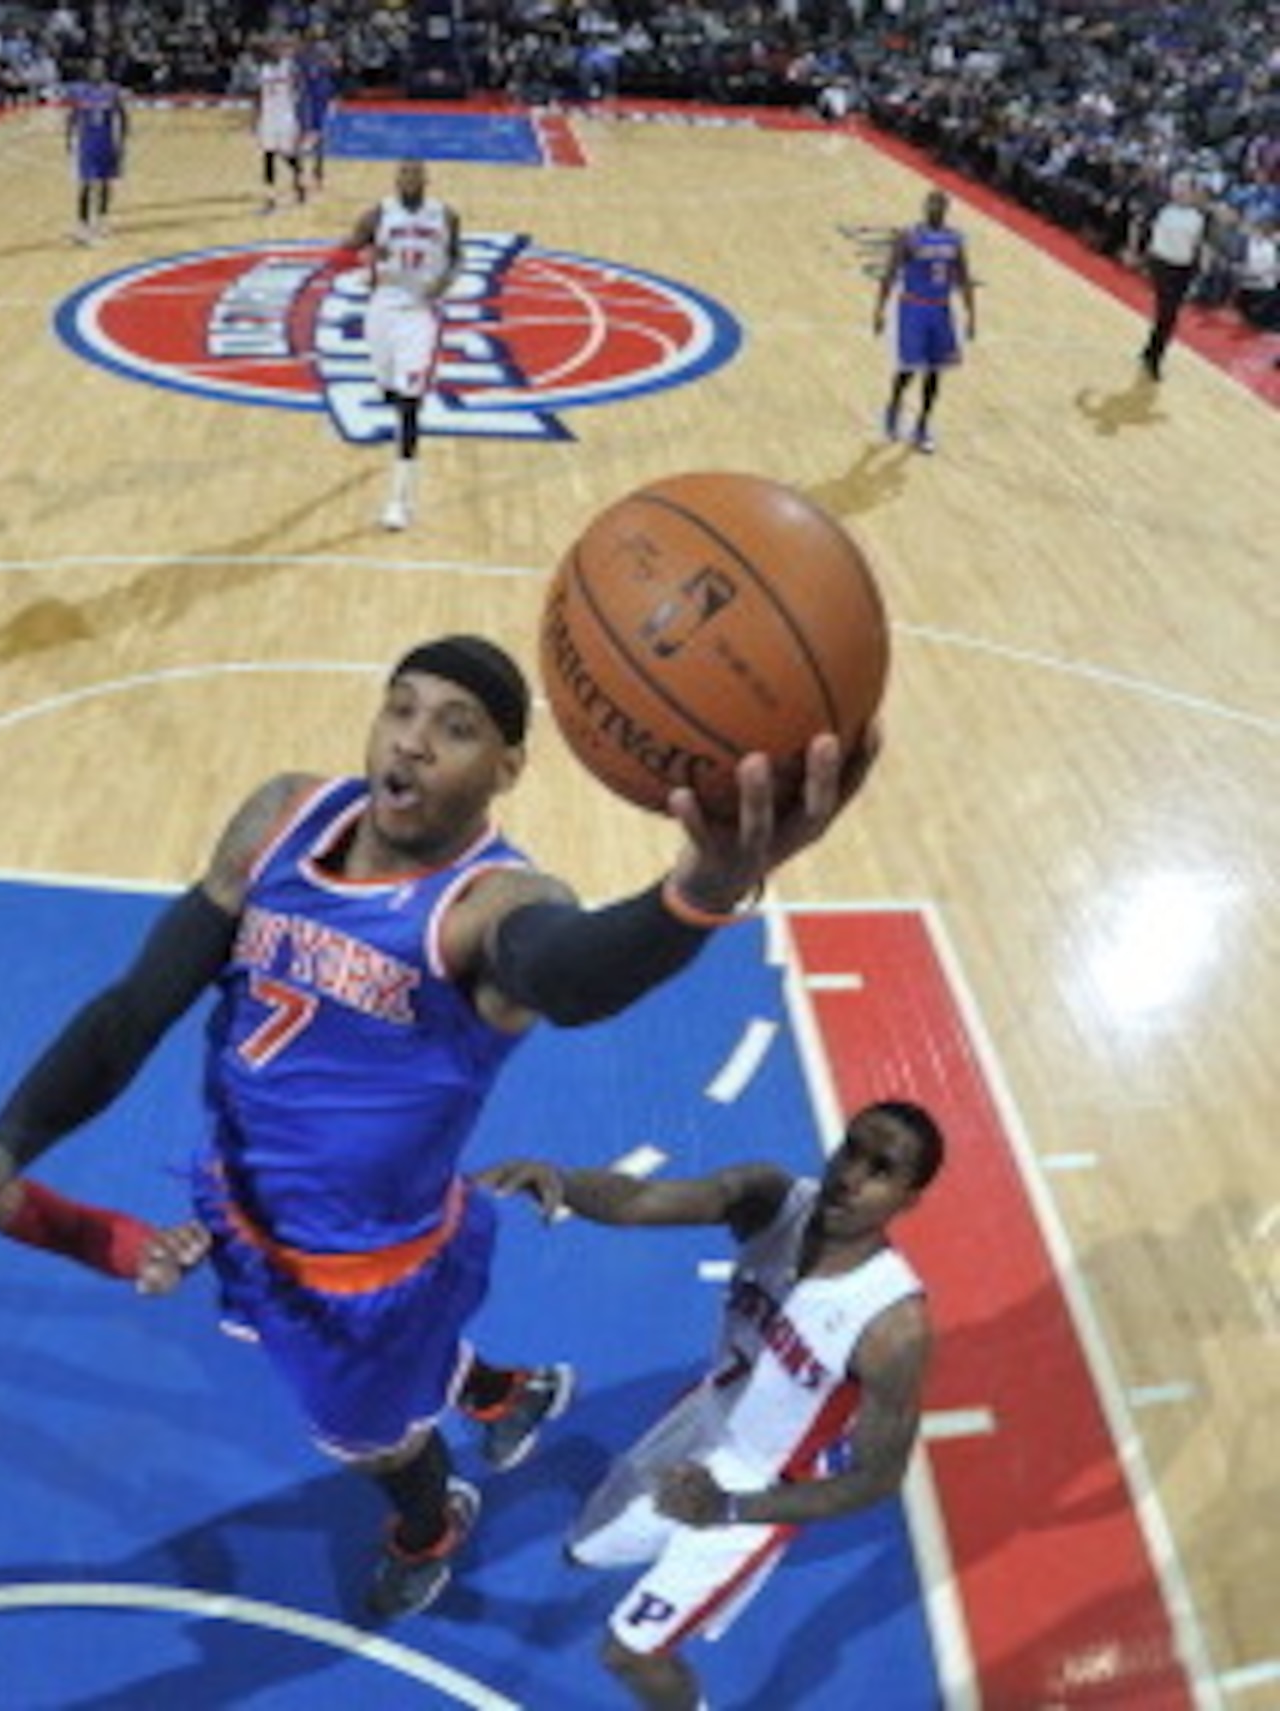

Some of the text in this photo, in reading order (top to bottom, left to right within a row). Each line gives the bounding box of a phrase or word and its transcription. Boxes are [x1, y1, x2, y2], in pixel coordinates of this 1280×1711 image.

[314, 233, 578, 444] PISTO
[286, 913, 421, 1025] YORK
[237, 979, 318, 1072] 7
[627, 1591, 675, 1627] P
